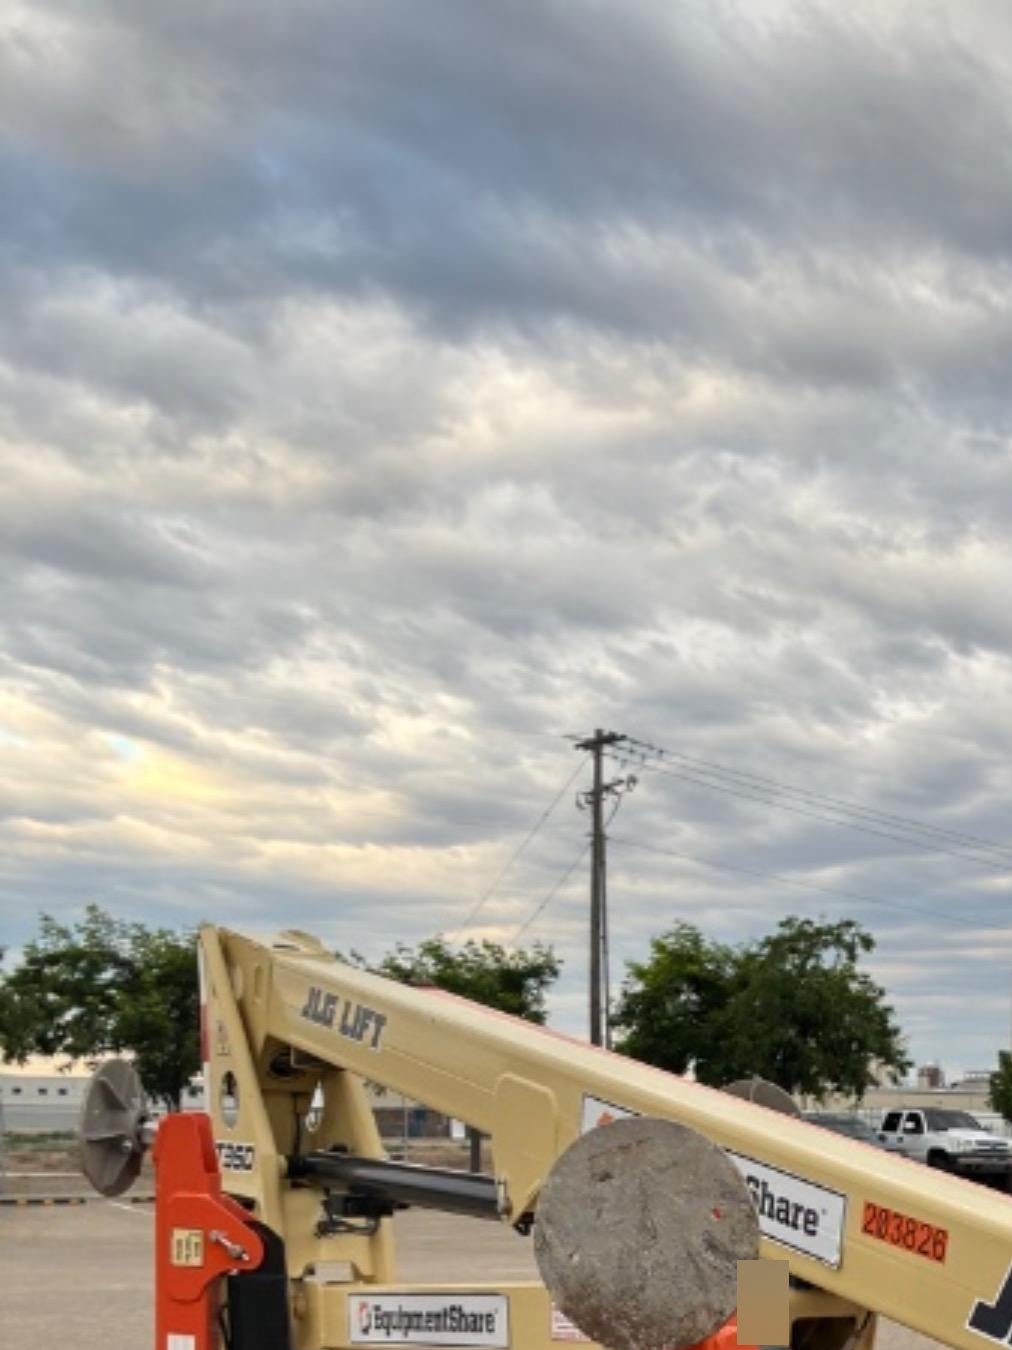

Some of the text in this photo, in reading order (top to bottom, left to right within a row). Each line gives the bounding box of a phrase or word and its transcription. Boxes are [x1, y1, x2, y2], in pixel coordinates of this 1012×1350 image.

[301, 986, 387, 1049] JLG LIFT
[862, 1201, 949, 1262] 203826
[372, 1304, 497, 1338] EquipmentShare
